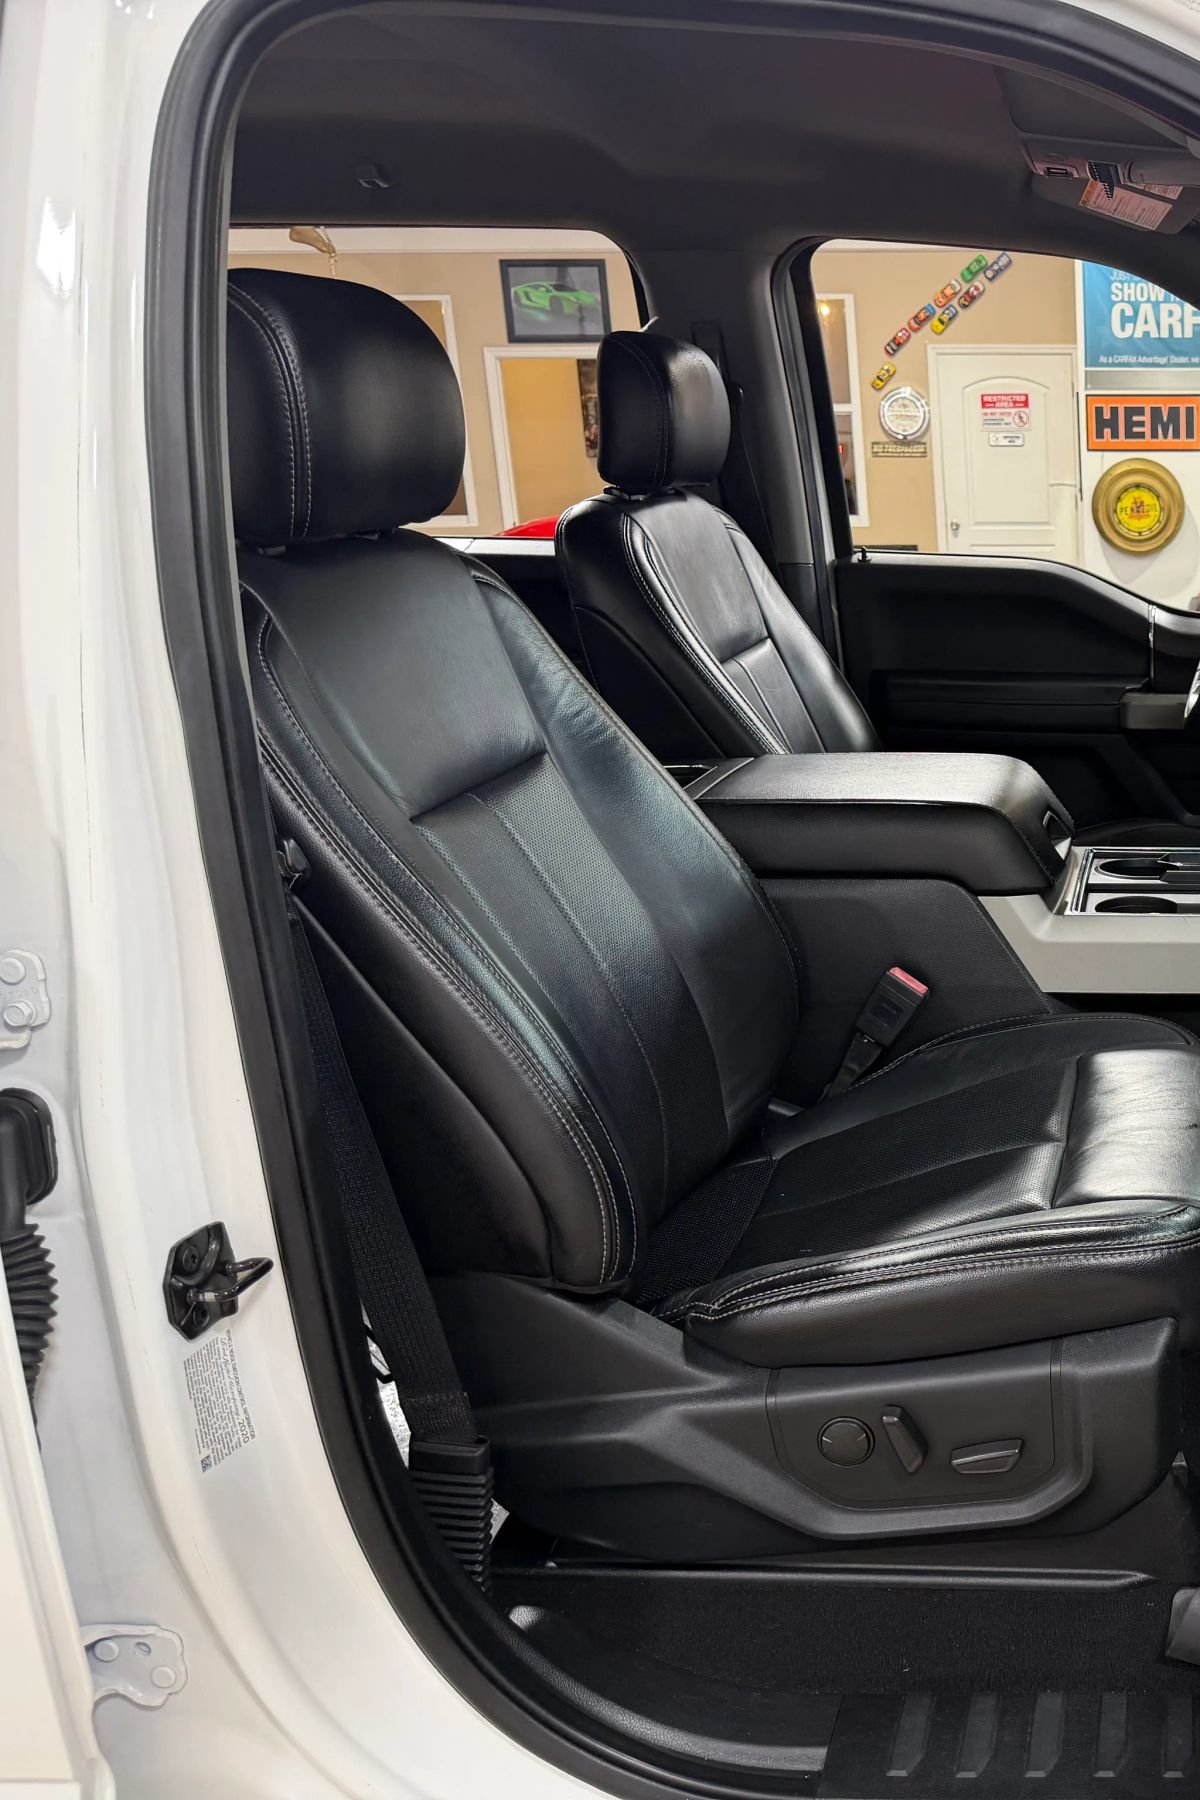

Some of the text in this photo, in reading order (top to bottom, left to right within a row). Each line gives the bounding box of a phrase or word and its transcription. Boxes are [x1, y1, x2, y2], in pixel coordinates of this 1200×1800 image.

[1111, 282, 1164, 301] SHOW
[1094, 405, 1195, 440] HEMI
[238, 1420, 250, 1444] 2020
